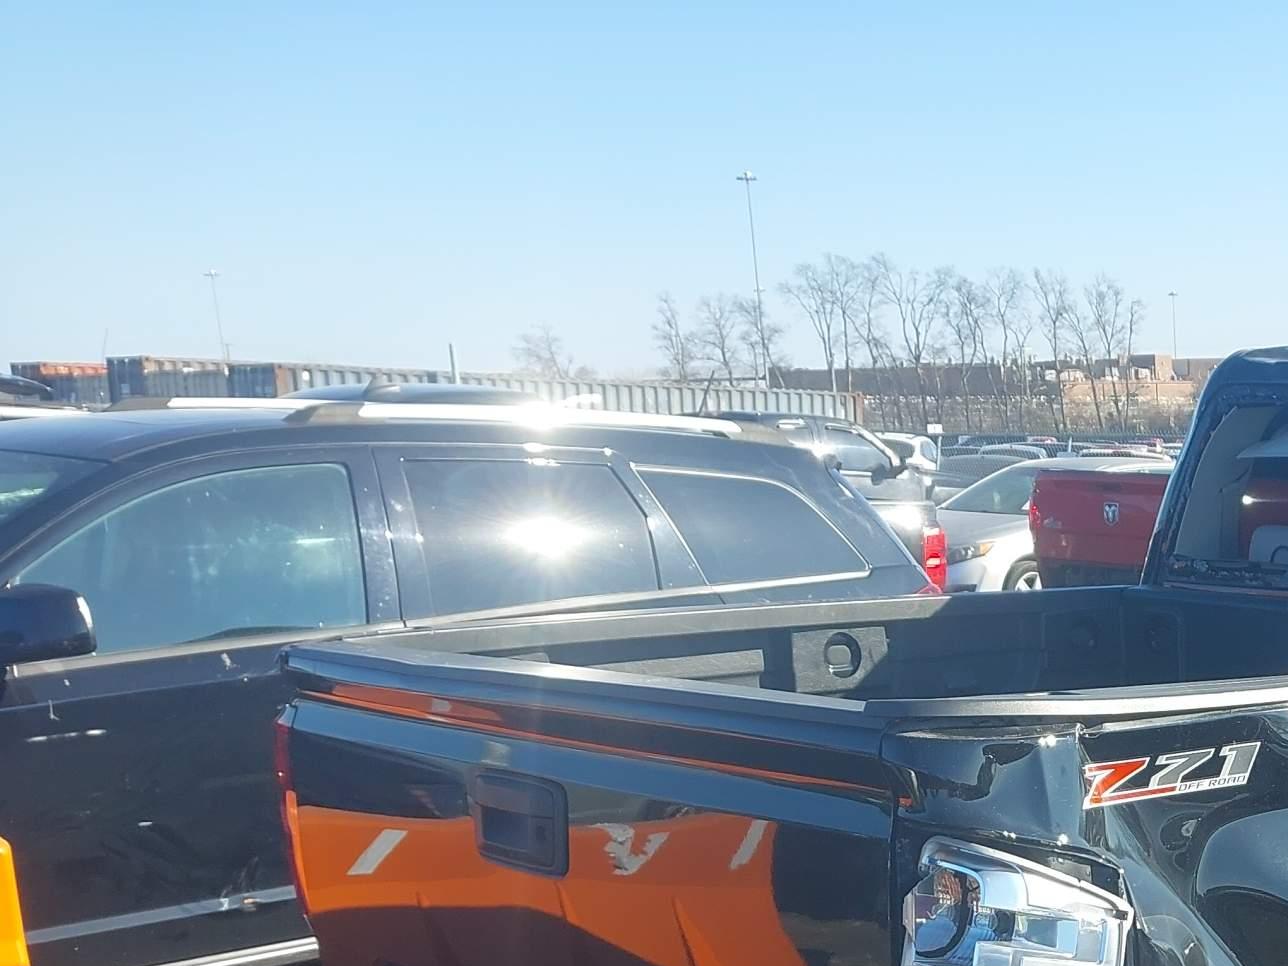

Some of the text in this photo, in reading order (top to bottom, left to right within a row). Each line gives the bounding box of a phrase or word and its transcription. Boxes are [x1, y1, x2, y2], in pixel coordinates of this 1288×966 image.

[1083, 742, 1262, 810] Z71
[1178, 775, 1247, 792] OFF ROAD
